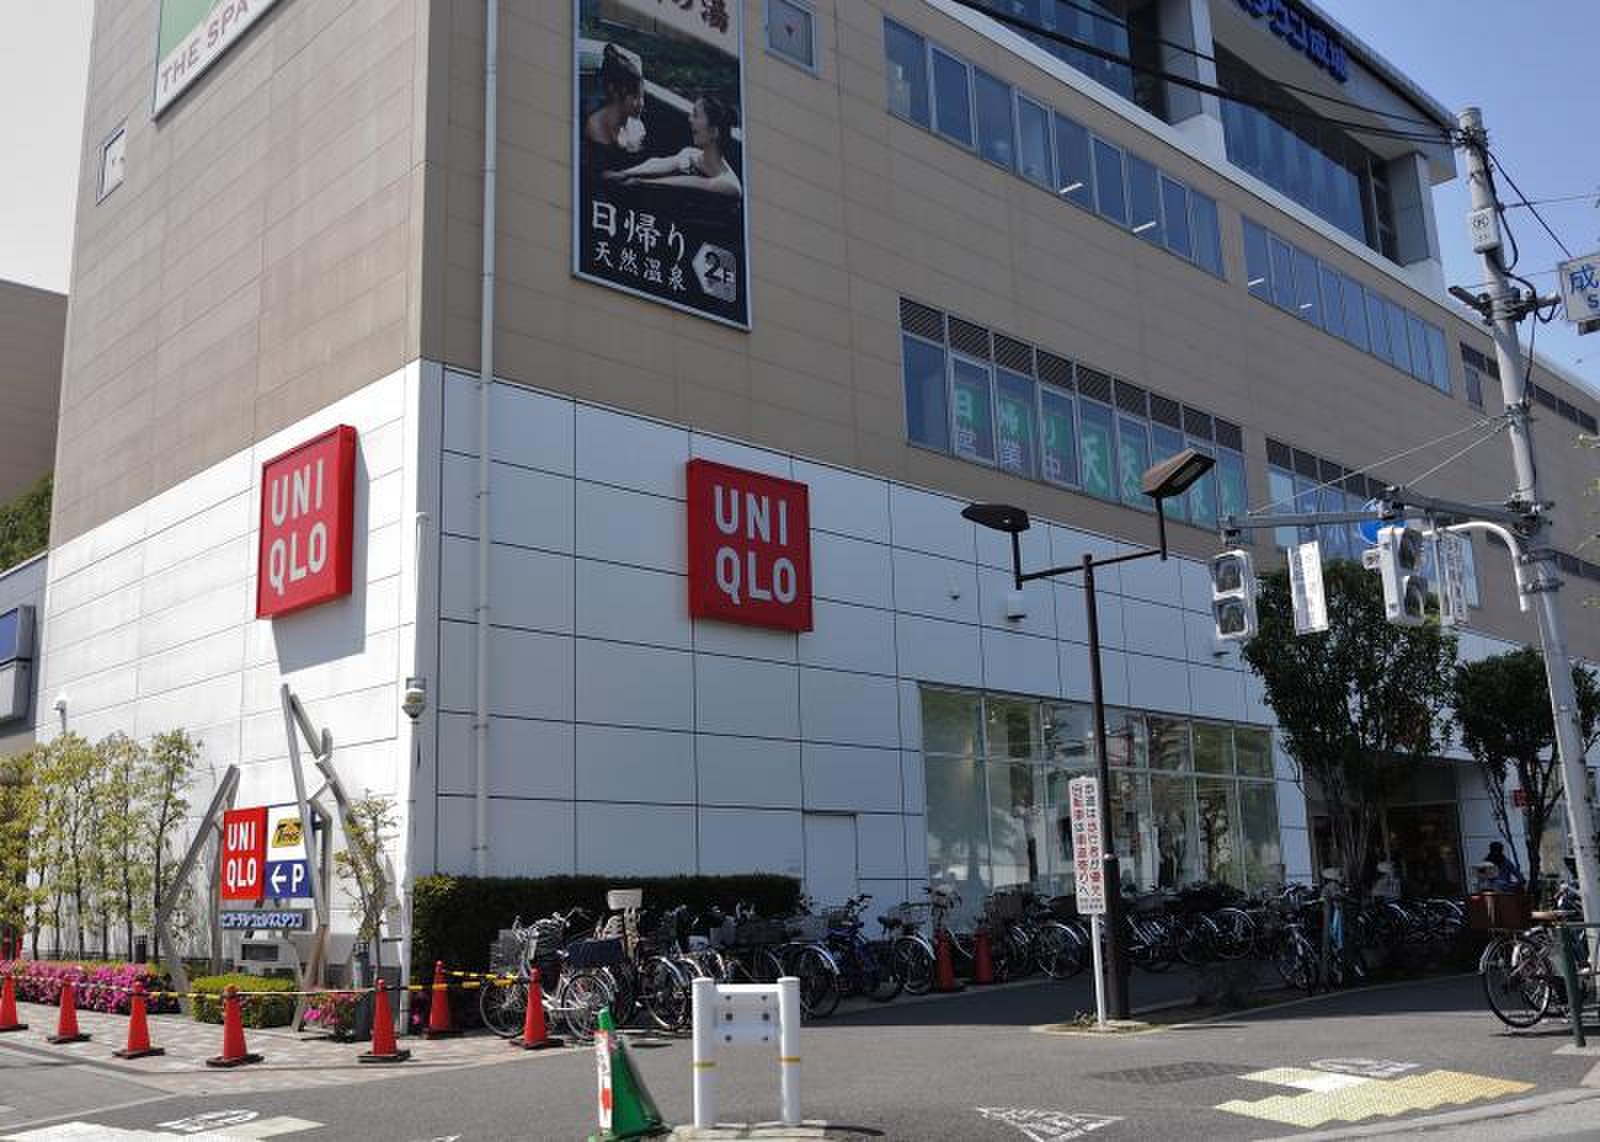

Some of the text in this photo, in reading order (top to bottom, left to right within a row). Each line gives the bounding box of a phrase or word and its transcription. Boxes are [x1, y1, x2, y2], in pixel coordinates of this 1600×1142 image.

[161, 38, 201, 92] THE
[592, 200, 685, 263] 日帰り
[592, 241, 687, 291] 天然温泉
[271, 457, 324, 527] UNI
[714, 484, 788, 546] UNI
[269, 521, 327, 596] QLO
[715, 545, 797, 605] QLO
[227, 821, 257, 851] UNI
[226, 856, 257, 893] QLO
[291, 863, 305, 893] P
